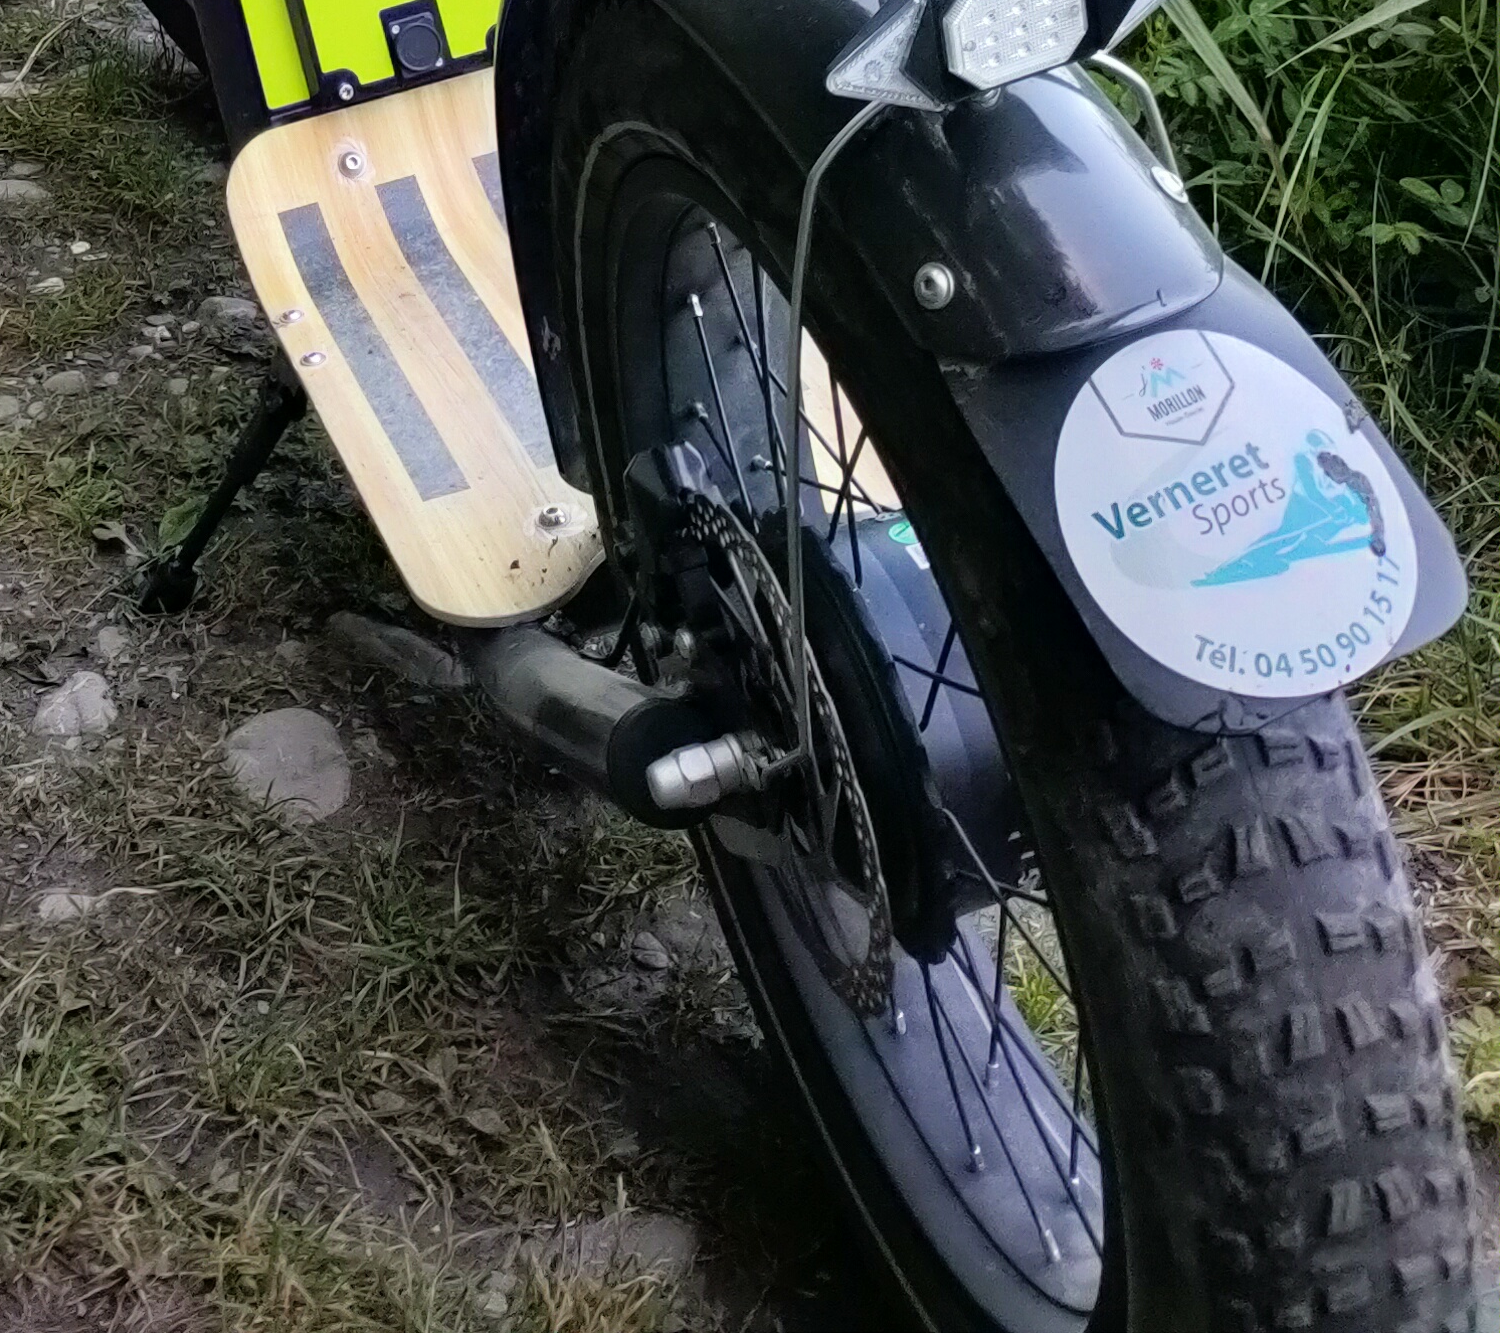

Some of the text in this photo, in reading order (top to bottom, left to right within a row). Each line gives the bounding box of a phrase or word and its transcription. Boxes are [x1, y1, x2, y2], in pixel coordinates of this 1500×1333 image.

[1146, 384, 1207, 422] MORILLON
[1091, 441, 1270, 540] Verneret
[1192, 477, 1287, 536] Sports
[1254, 652, 1294, 678] 04
[1299, 642, 1337, 675] 50
[1336, 622, 1371, 659] 90
[1363, 589, 1393, 625] 15
